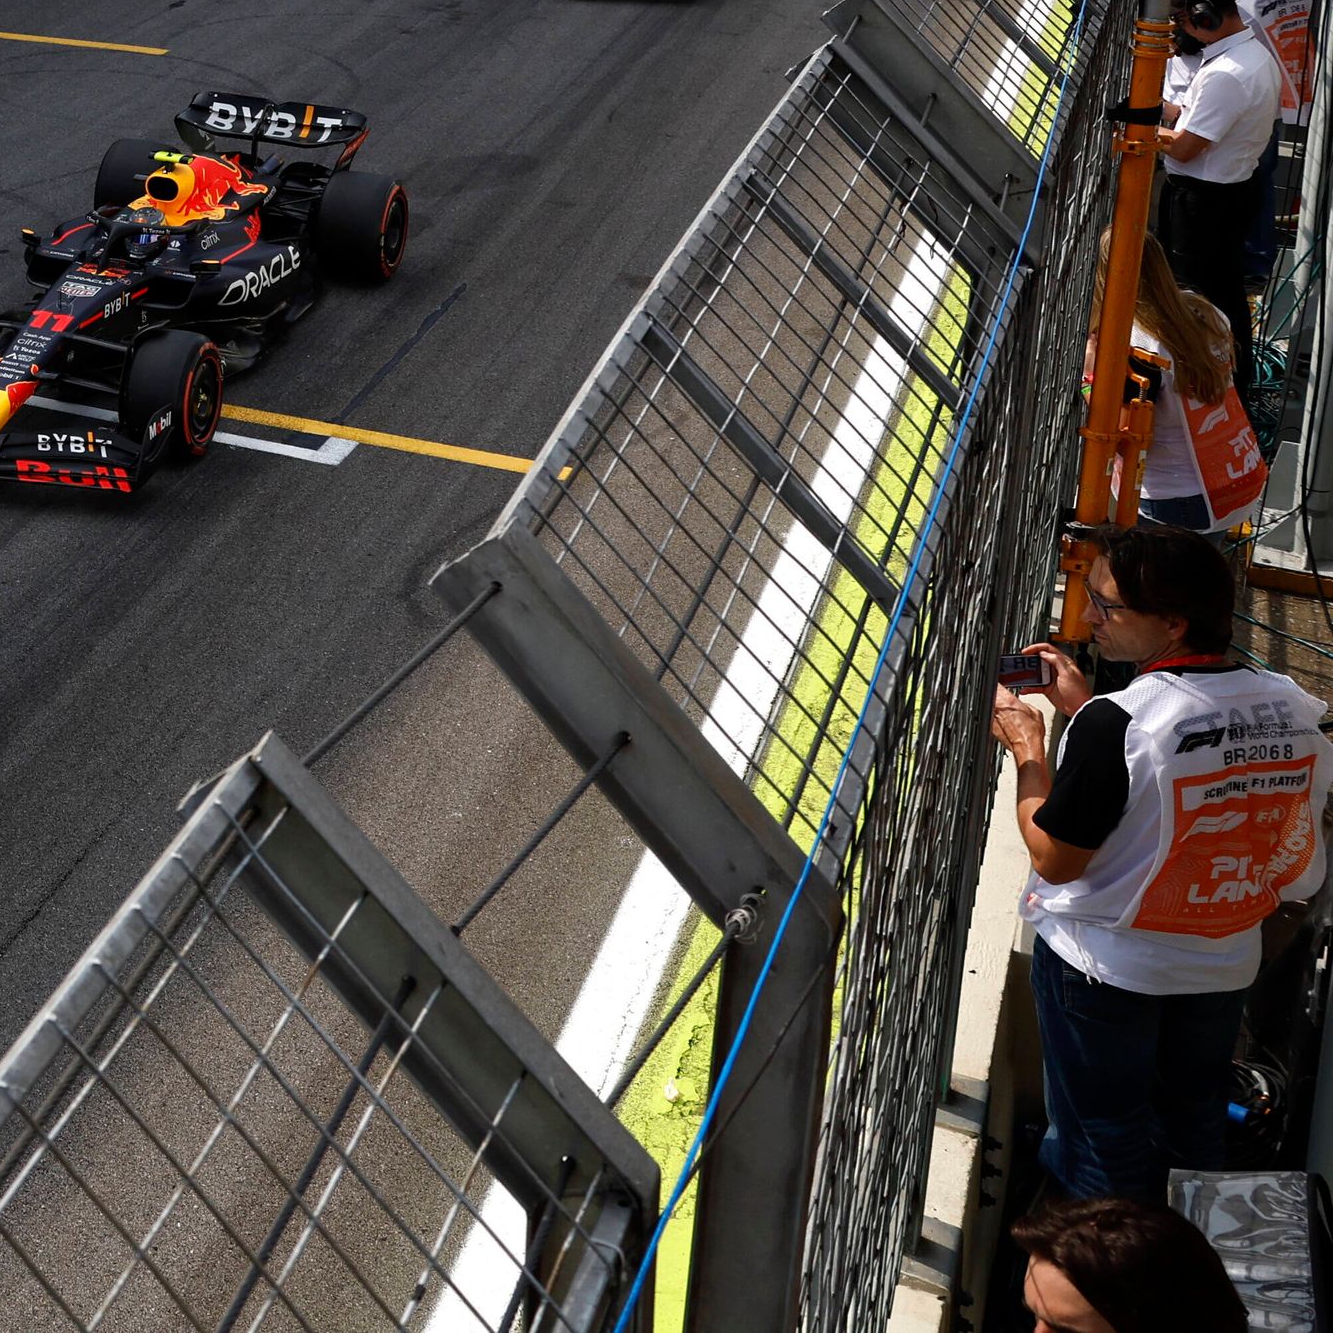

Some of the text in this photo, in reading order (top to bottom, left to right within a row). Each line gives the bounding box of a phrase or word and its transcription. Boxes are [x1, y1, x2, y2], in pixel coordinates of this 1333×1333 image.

[204, 101, 343, 143] BYBIT
[200, 231, 221, 251] citrix
[65, 274, 116, 286] ORACLE
[217, 245, 302, 307] ORACLE
[104, 291, 131, 318] BYBIT
[29, 309, 75, 333] 11
[17, 337, 48, 349] citrix
[20, 346, 41, 355] Tezos
[148, 410, 173, 441] Mobil
[37, 429, 113, 459] BYBIT
[15, 459, 132, 493] Bull
[1225, 445, 1262, 480] LAN
[1187, 879, 1263, 904] LAN
